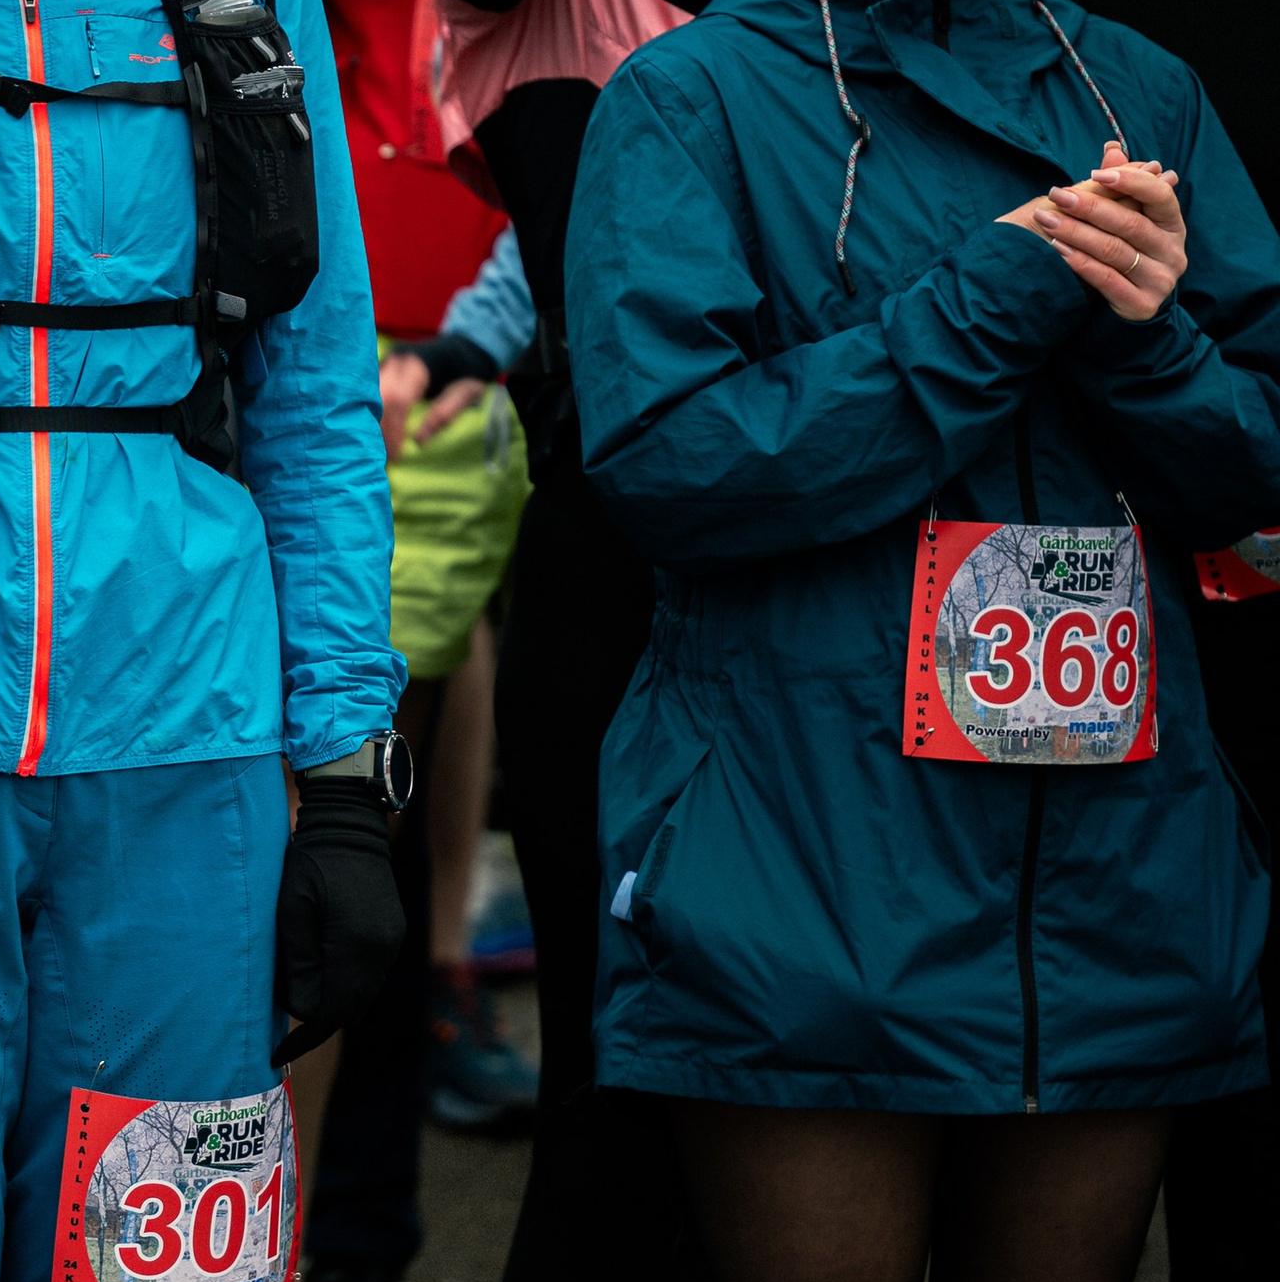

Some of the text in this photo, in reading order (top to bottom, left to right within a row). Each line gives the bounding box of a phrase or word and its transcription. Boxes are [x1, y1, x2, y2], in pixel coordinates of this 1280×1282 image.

[1039, 534, 1115, 553] Gârboavele
[1053, 559, 1114, 592] & RIDE
[1069, 551, 1115, 572] RUN
[924, 546, 937, 614] TRAIL
[920, 634, 931, 673] RUN
[965, 605, 1140, 710] 368
[965, 724, 1050, 742] Powered by
[1069, 721, 1115, 734] maus
[192, 1101, 267, 1125] Gârboavele
[220, 1117, 266, 1141] RUN
[75, 1117, 90, 1184] TRAIL
[206, 1134, 265, 1163] & RIDE
[69, 1203, 80, 1241] RUN
[114, 1160, 284, 1281] 301
